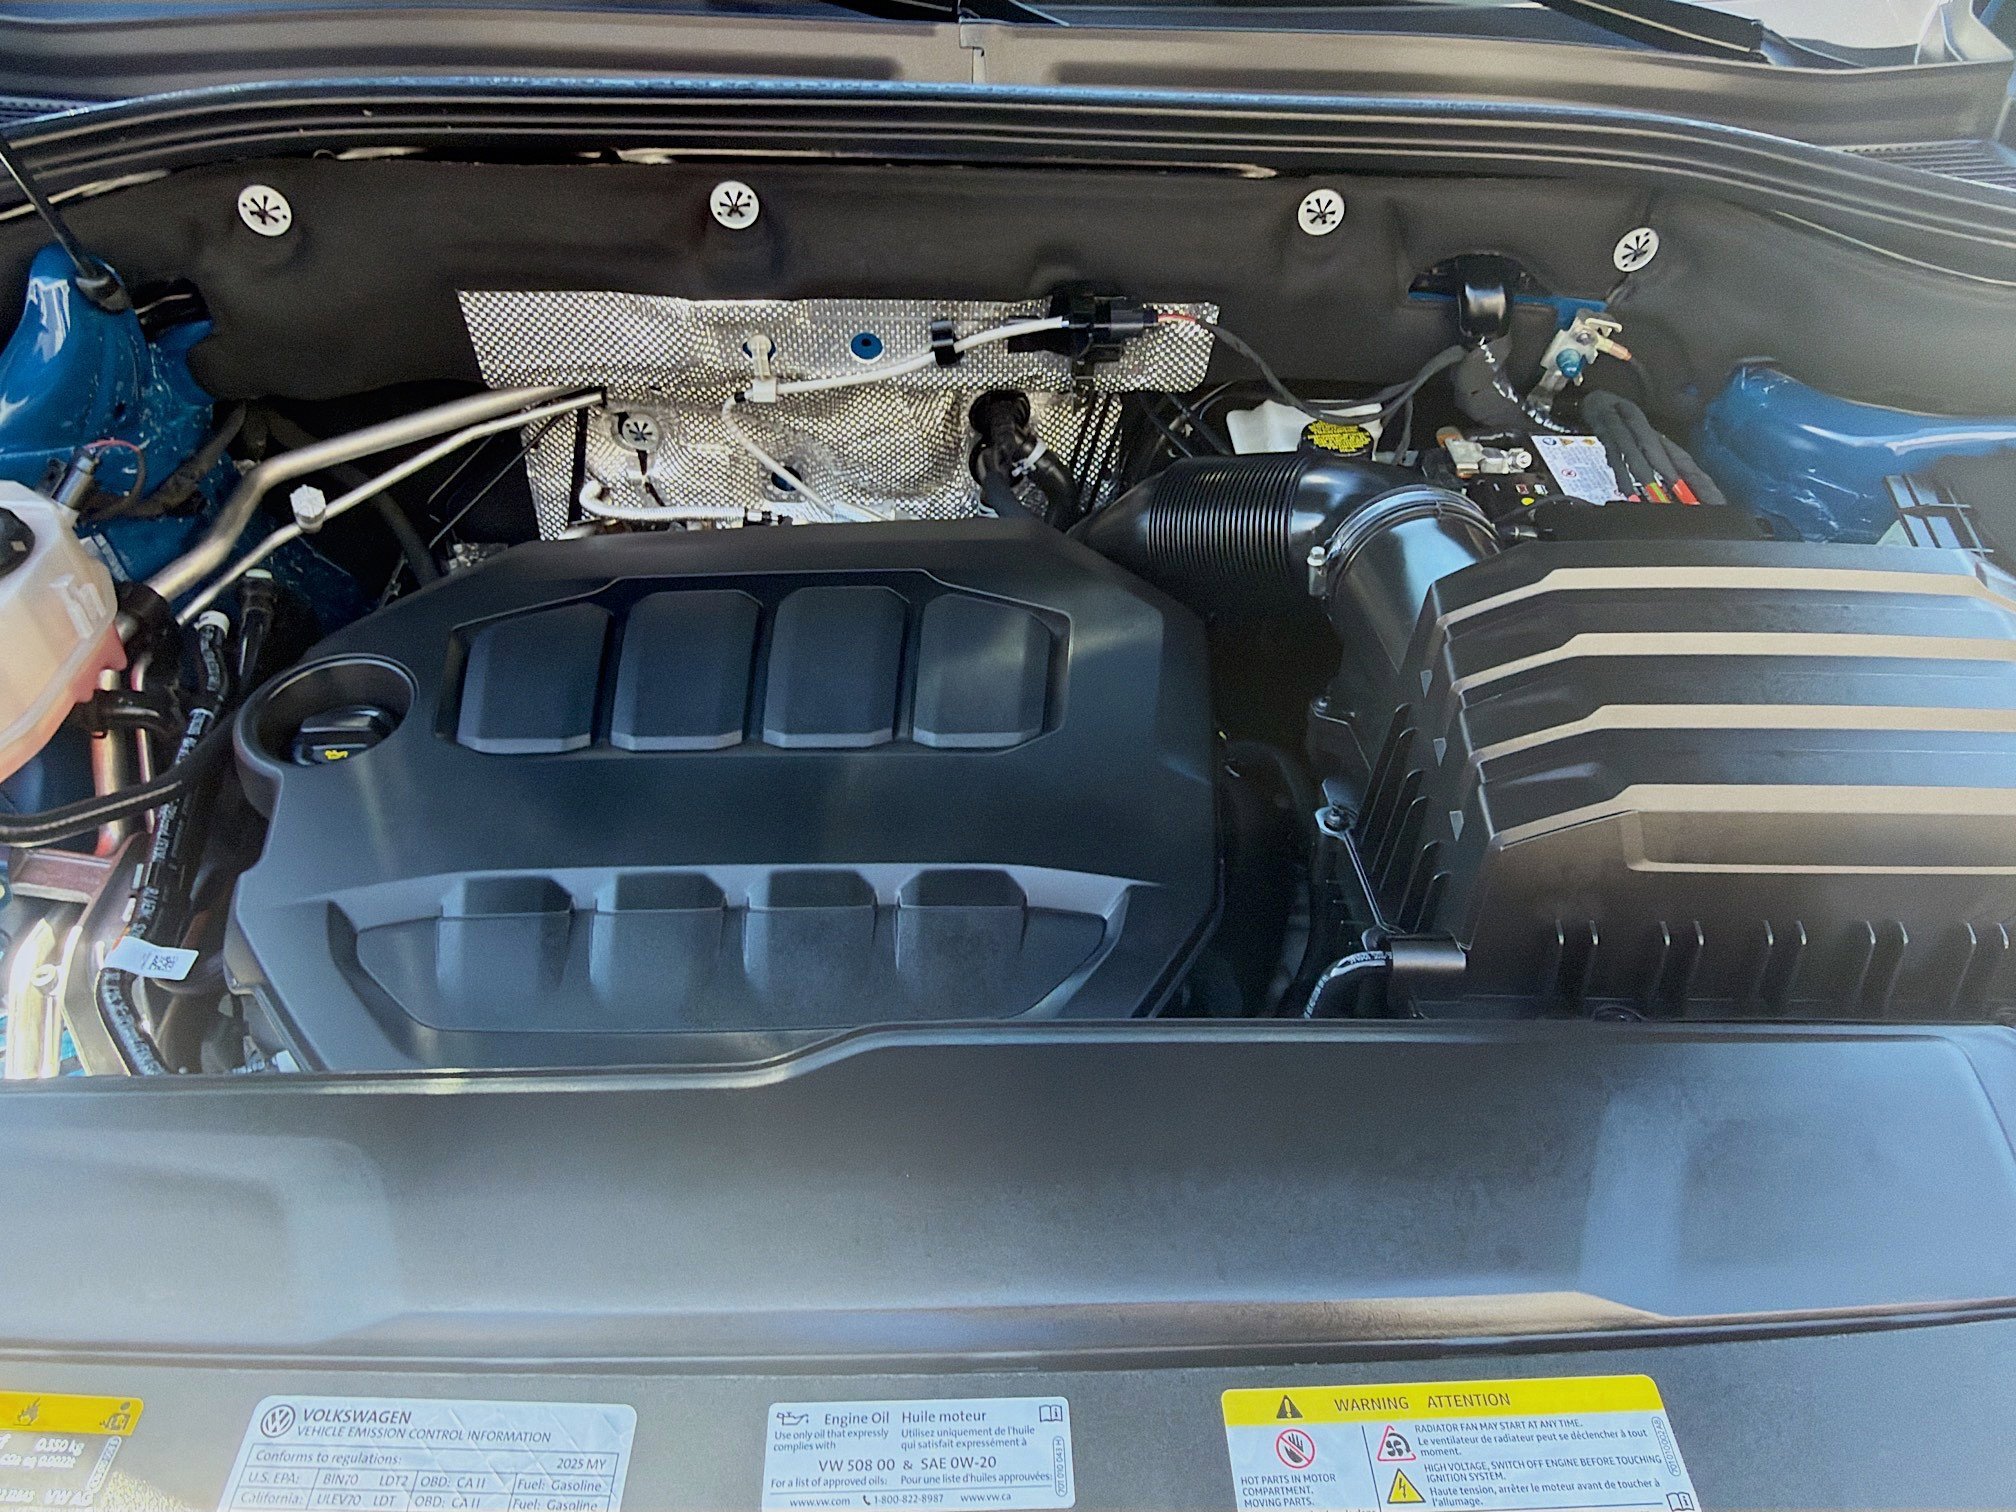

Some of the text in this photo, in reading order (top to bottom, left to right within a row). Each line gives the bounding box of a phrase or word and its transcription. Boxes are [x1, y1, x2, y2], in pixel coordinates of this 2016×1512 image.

[1334, 1393, 1511, 1412] WARNING ATTENTION
[304, 1408, 412, 1424] VOLKSWAGEN
[824, 1411, 889, 1428] Engine Oil
[902, 1411, 987, 1423] Huile moteur
[902, 1425, 1035, 1438] Utilisez uniquement de l'huile
[1415, 1419, 1583, 1433] RADIATOR FAN MAY START AT ANY TIME.
[298, 1426, 551, 1442] VEHICLE EMISSION CONTROL INFORMATION
[775, 1428, 889, 1440] Use only oil that expressly
[1418, 1429, 1647, 1446] Le ventilateur de radiateur peut se déclencher à tout
[773, 1441, 836, 1453] complies with
[901, 1437, 1027, 1451] qui satisfait expressément à
[256, 1449, 401, 1466] Conforms to regulations:
[1420, 1448, 1461, 1457] moment.
[557, 1458, 607, 1470] 2025 MY
[819, 1456, 997, 1472] VW 508 00 & SAE 0W-20
[1424, 1463, 1447, 1472] HIGH
[1491, 1460, 1524, 1470] SWITCH
[1527, 1460, 1543, 1468] OFF
[1546, 1457, 1578, 1467] ENGINE
[1580, 1456, 1615, 1466] BEFORE
[1616, 1455, 1662, 1465] TOUCHING
[249, 1472, 299, 1484] U.S. EPA:
[323, 1473, 408, 1487] BIN70 LDT2
[420, 1476, 450, 1487] OBD:
[457, 1478, 472, 1488] CA
[771, 1479, 785, 1488] For
[796, 1478, 810, 1487] list
[812, 1477, 822, 1487] of
[823, 1476, 867, 1488] approved
[901, 1475, 922, 1484] Pour
[923, 1476, 940, 1484] une
[943, 1473, 960, 1483] liste
[962, 1472, 996, 1483] d'huiles
[1241, 1474, 1336, 1485] HOT PARTS IN MOTOR
[1427, 1472, 1506, 1483] IGNITION SYSTEM.
[517, 1480, 601, 1492] Fuel: Gasoline
[1242, 1487, 1313, 1496] COMPARTMENT.
[1430, 1478, 1660, 1496] Haute tension, arrêter le moteur avant de toucher à
[241, 1492, 304, 1505] California:
[317, 1494, 396, 1506] ULEV70 LDT
[415, 1496, 445, 1507] OBD:
[451, 1497, 467, 1508] CA
[513, 1498, 597, 1511] Fuel: Gasoline
[790, 1498, 850, 1507] www.vw.com
[960, 1494, 1012, 1503] www.vw.ca
[1244, 1498, 1314, 1508] MOVING PARTS.
[1433, 1497, 1483, 1507] l'allumage.
